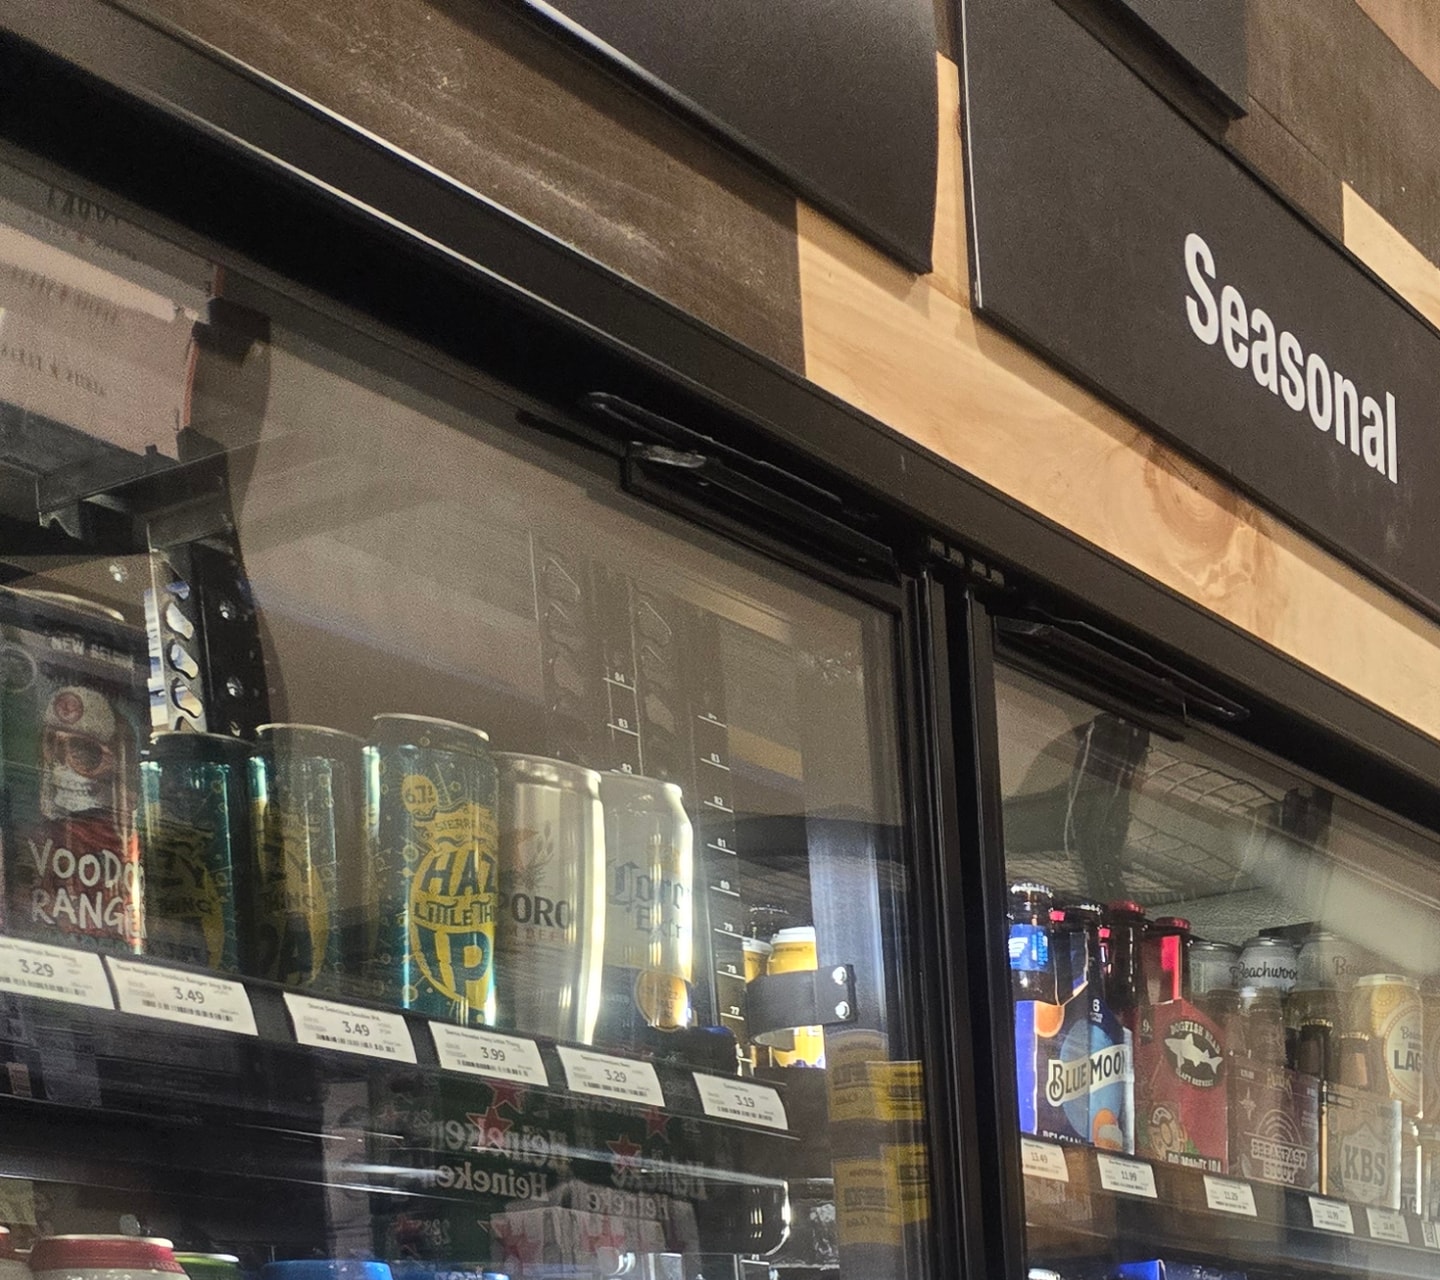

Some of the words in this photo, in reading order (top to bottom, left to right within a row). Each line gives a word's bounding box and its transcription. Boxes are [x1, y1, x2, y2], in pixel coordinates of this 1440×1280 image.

[1184, 234, 1398, 483] Seasonal
[20, 958, 54, 978] 3.29
[175, 986, 205, 1004] 3.49
[342, 1020, 370, 1037] 3.49
[482, 1047, 506, 1062] 3.99
[604, 1068, 627, 1083] 3.29
[1047, 1060, 1087, 1107] BLUE
[735, 1094, 755, 1108] 3.19
[1343, 1144, 1386, 1186] KBS
